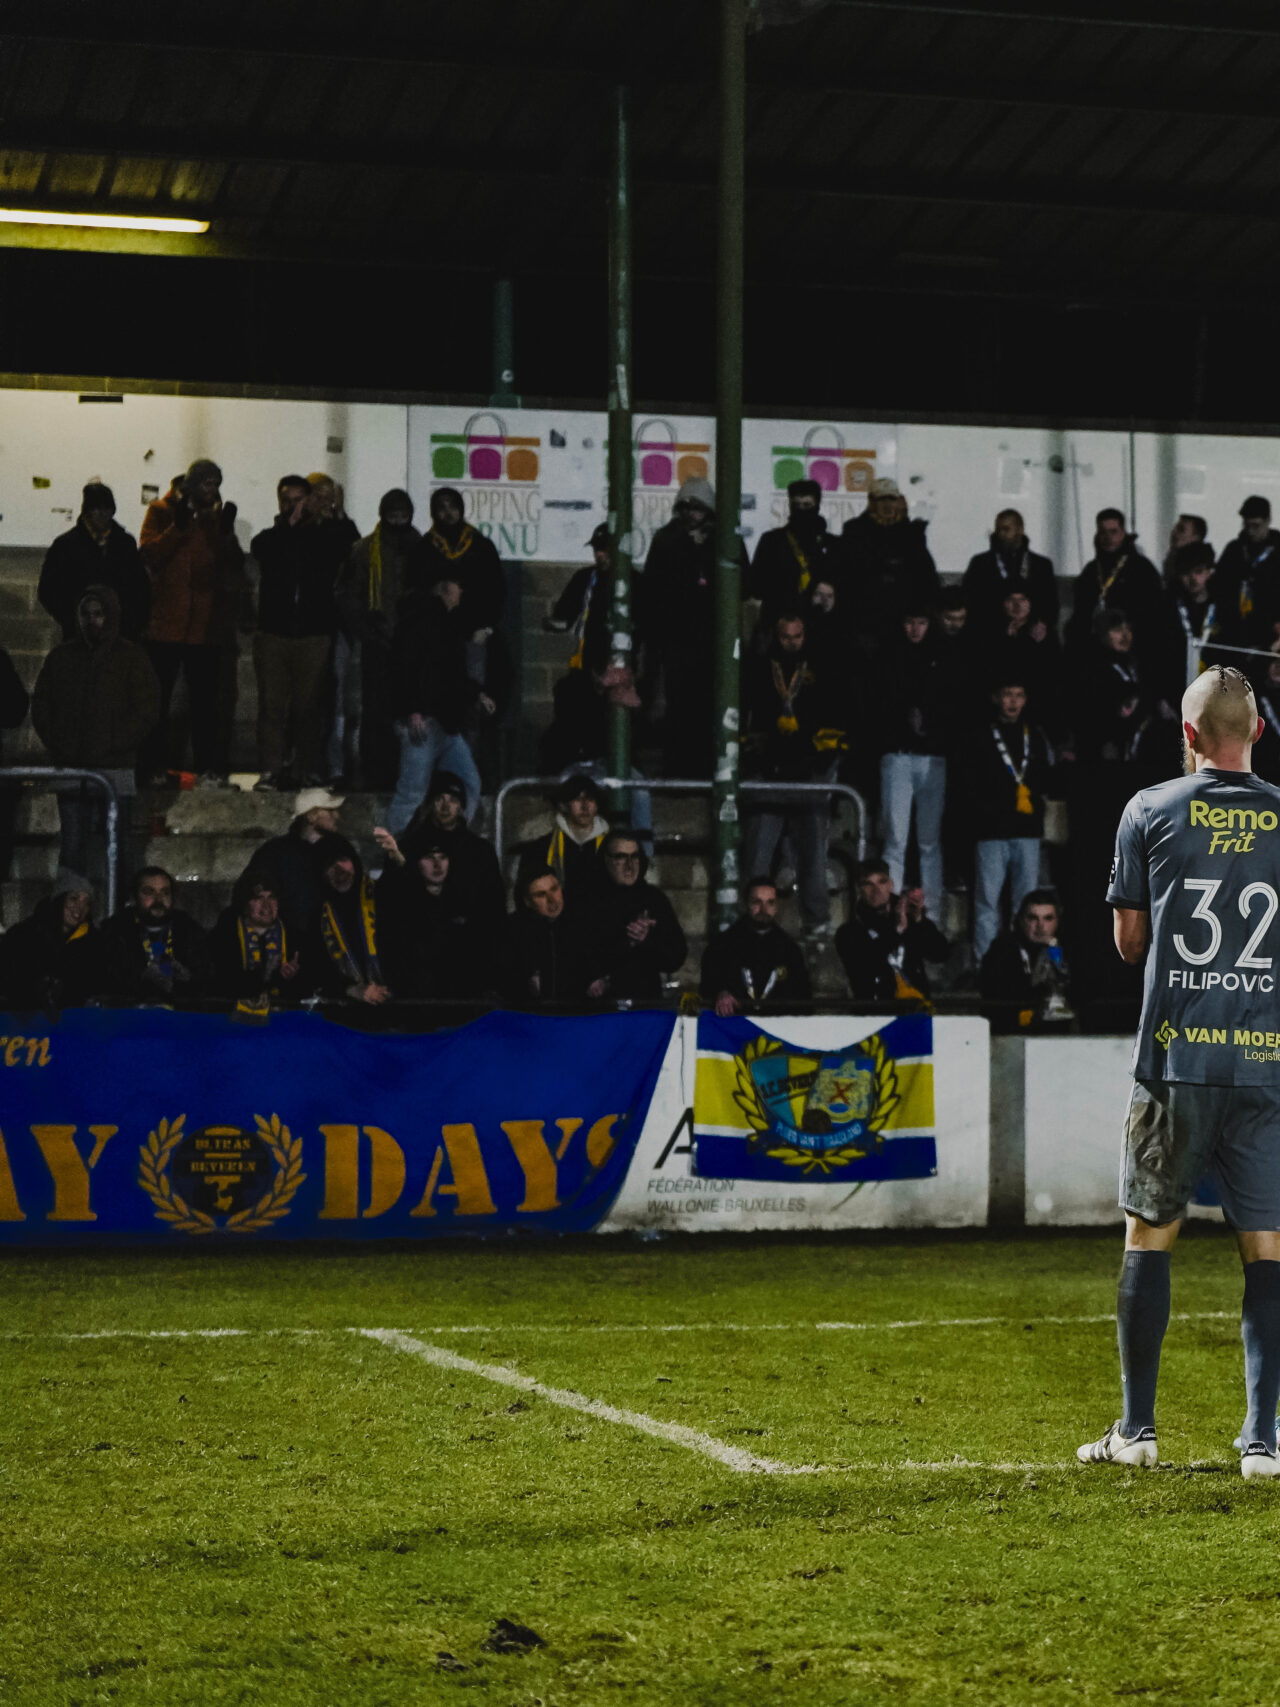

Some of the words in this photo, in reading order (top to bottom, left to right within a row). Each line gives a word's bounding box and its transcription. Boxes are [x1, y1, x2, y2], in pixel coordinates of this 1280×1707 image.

[1190, 800, 1278, 831] Remo
[1208, 830, 1256, 855] Frit
[1173, 878, 1278, 969] 32
[1184, 1027, 1227, 1044] VAN
[647, 1178, 735, 1194] FÉDÉRATION
